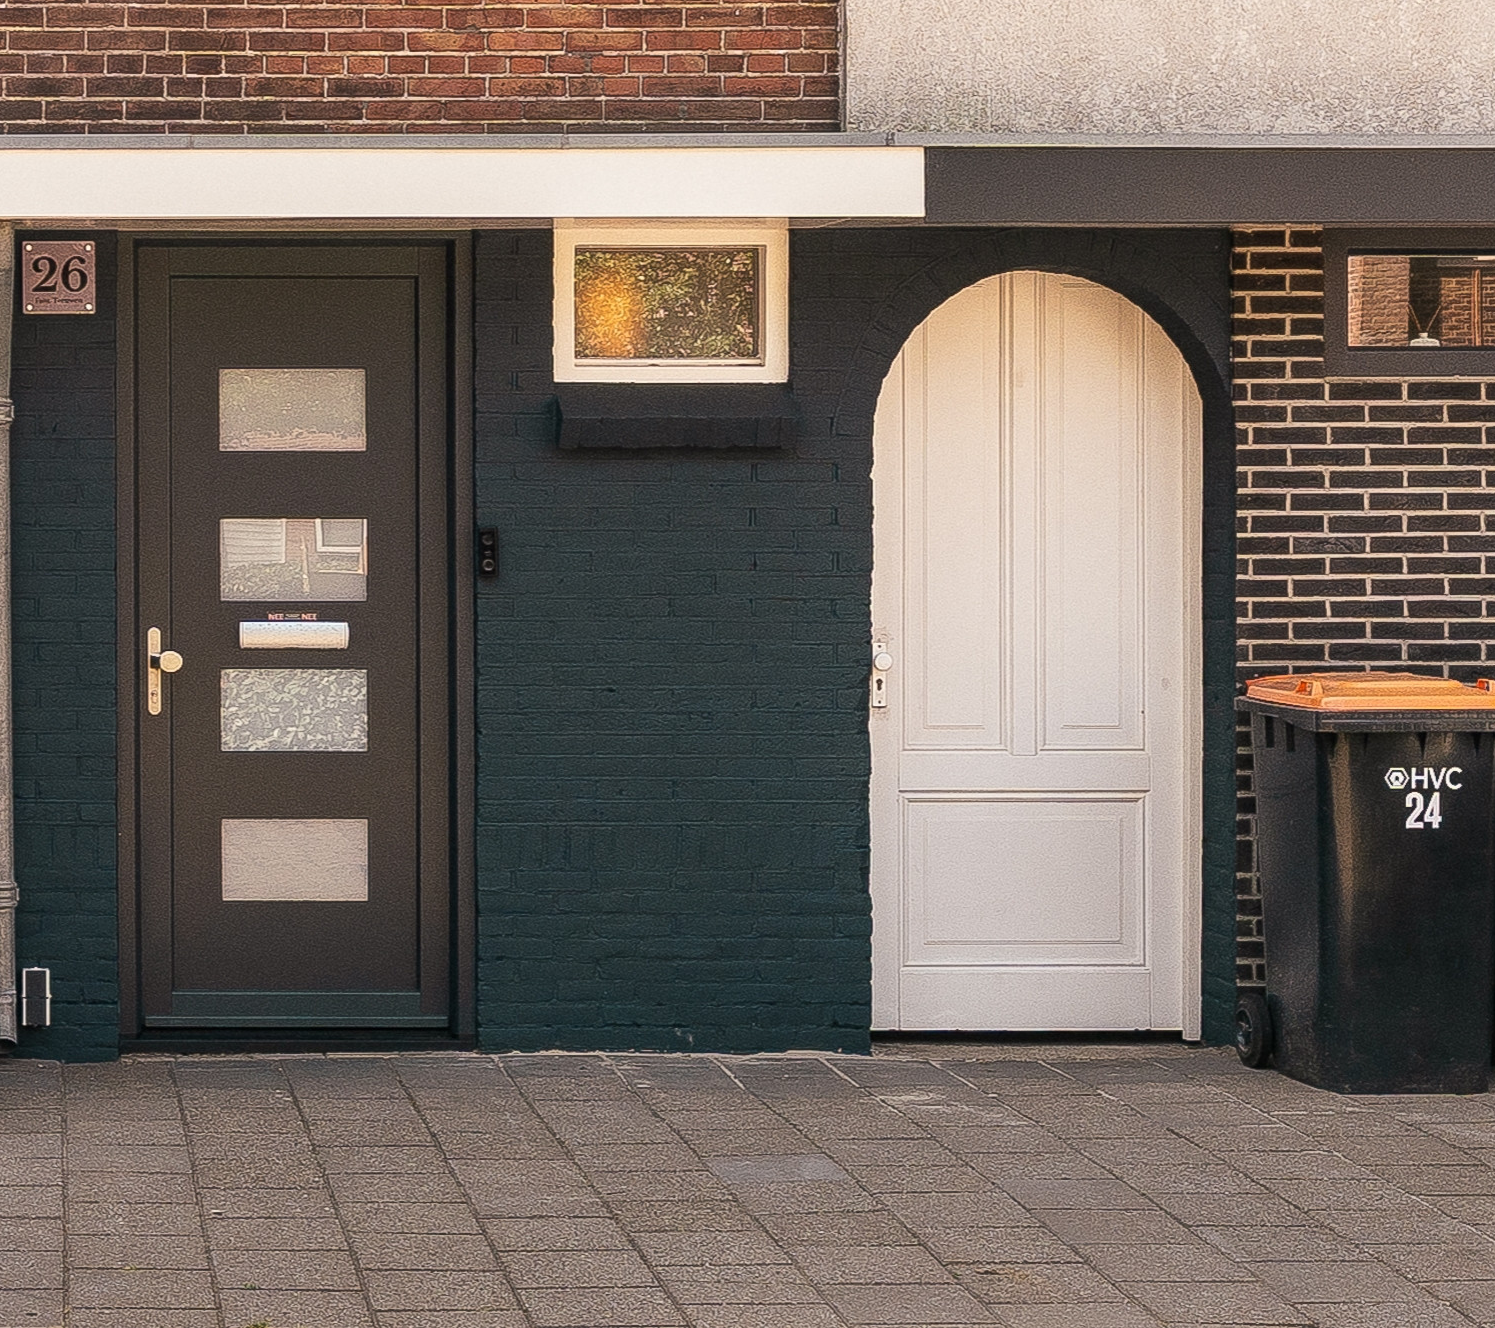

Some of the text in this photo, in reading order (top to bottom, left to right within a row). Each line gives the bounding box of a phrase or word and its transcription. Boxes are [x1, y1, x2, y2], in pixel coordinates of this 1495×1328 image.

[32, 255, 88, 293] 26
[1411, 766, 1463, 790] HVC
[1405, 792, 1442, 830] 24
